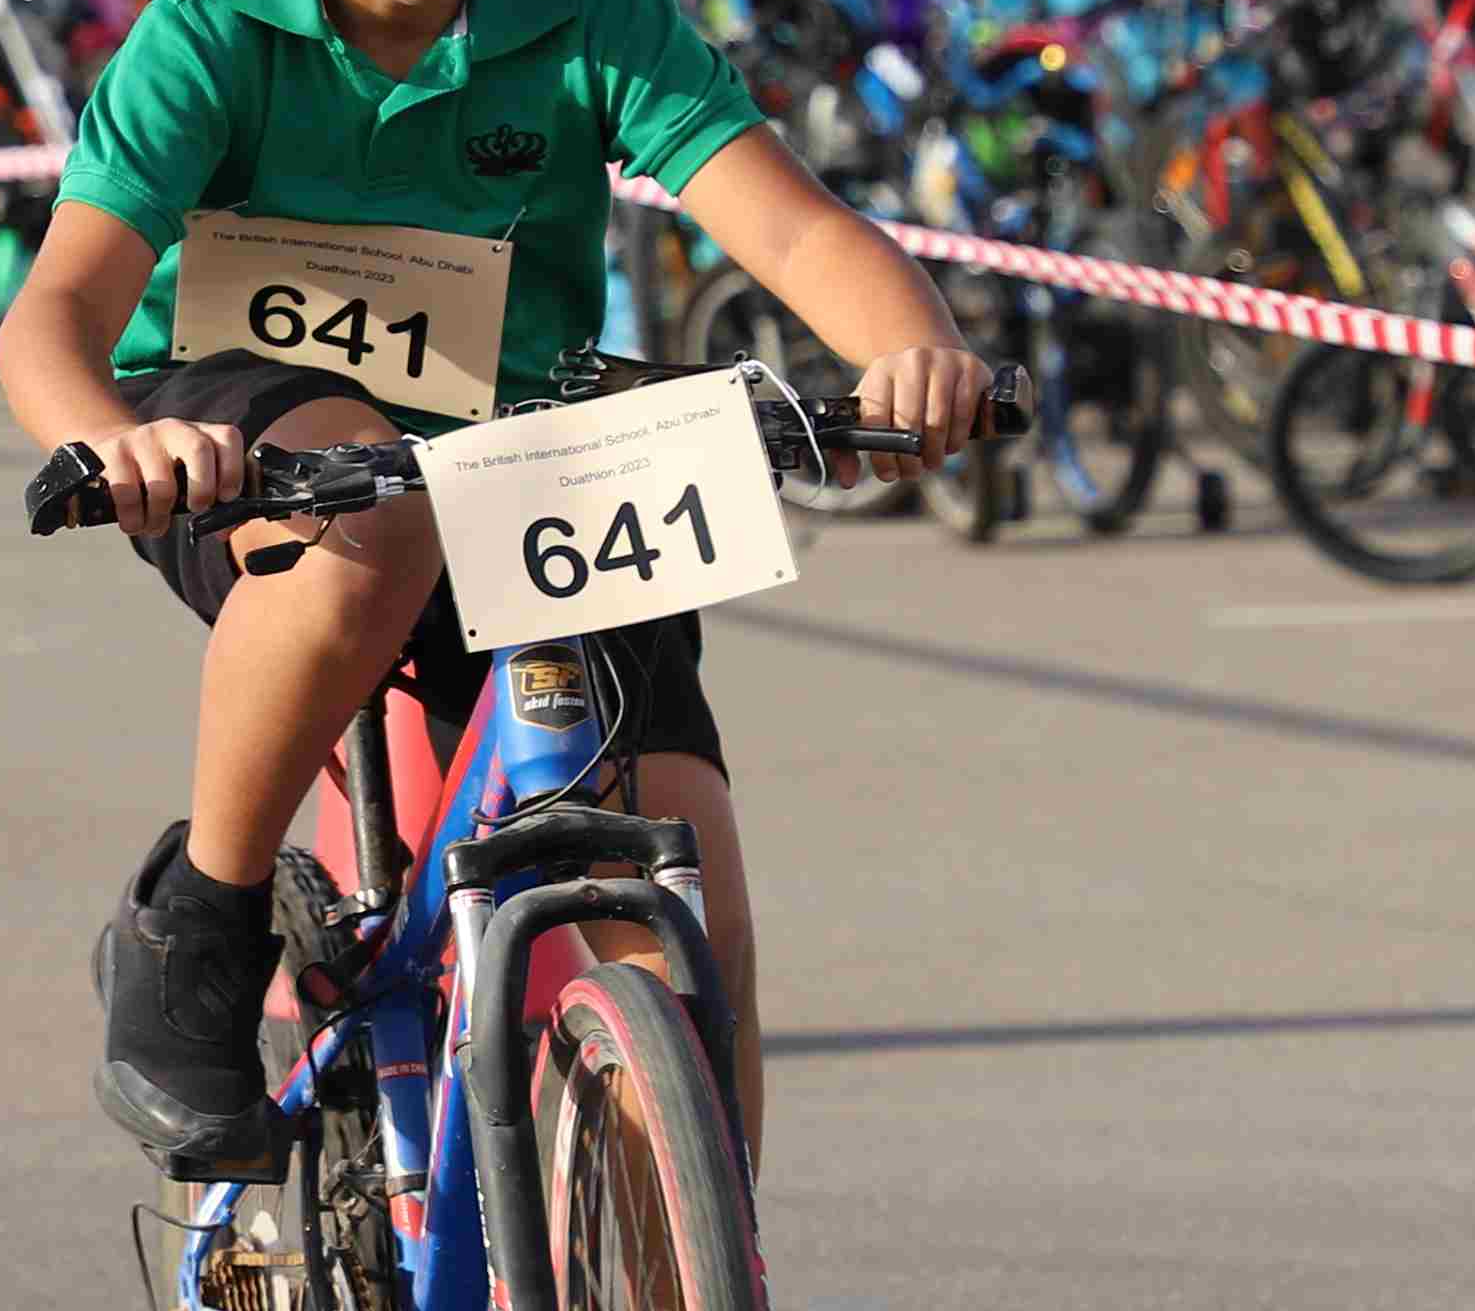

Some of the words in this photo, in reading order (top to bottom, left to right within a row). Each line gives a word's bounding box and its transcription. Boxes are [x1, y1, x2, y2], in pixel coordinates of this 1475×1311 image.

[212, 231, 236, 241] The
[239, 232, 277, 244] British
[280, 236, 358, 254] International
[360, 245, 403, 262] School,
[409, 255, 434, 268] Abu
[437, 259, 474, 275] Dhabi
[305, 260, 361, 278] Duathlon
[364, 269, 395, 284] 2023
[248, 284, 429, 378] 641
[455, 460, 480, 473] The
[482, 451, 523, 468] British
[525, 437, 602, 461] International
[604, 427, 651, 447] School,
[655, 418, 680, 432] Abu
[683, 406, 721, 426] Dhabi
[558, 468, 616, 488] Duathlon
[619, 457, 651, 474] 2023
[522, 483, 716, 599] 641
